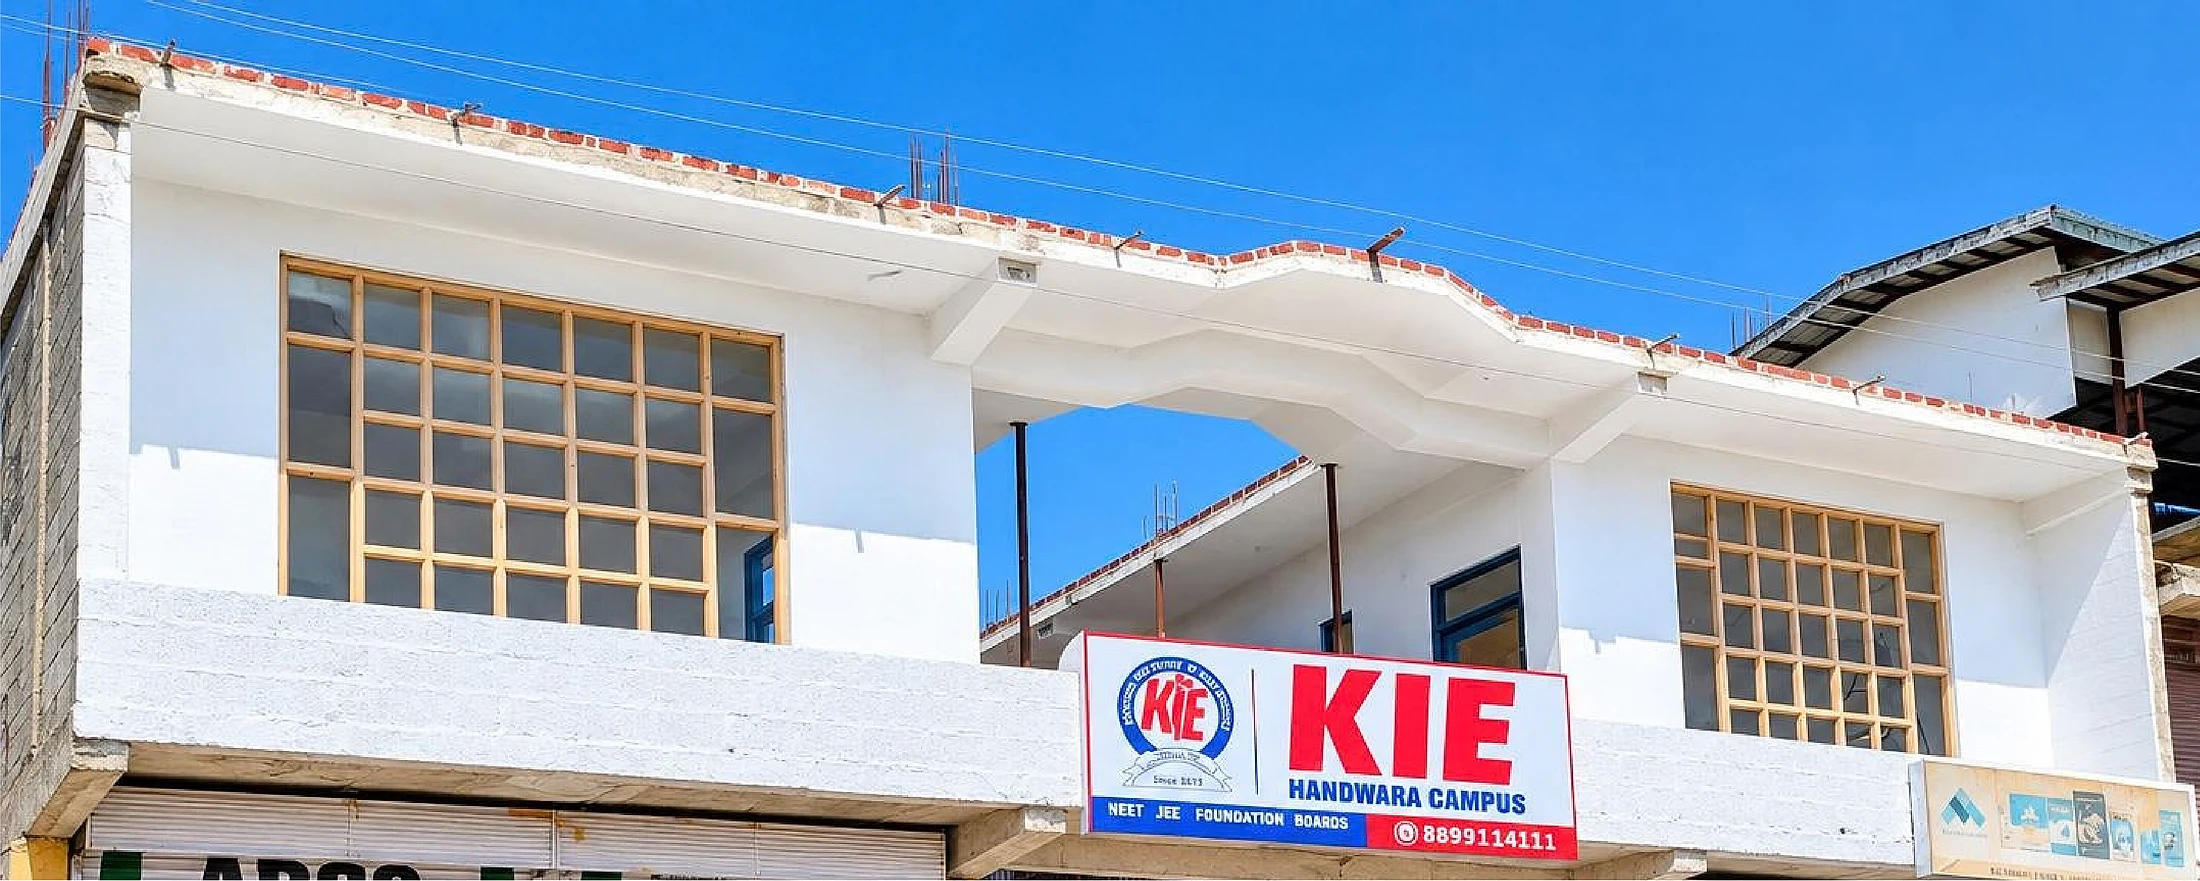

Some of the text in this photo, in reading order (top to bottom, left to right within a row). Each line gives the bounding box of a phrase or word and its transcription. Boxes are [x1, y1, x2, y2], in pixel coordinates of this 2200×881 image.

[1141, 673, 1208, 741] KIE
[1289, 663, 1516, 785] KIE
[1288, 778, 1526, 815] HANDWARA CAMPUS
[1107, 802, 1349, 830] NEET JEE FOUNDATION BOARDS
[1422, 825, 1557, 851] 8899114111
